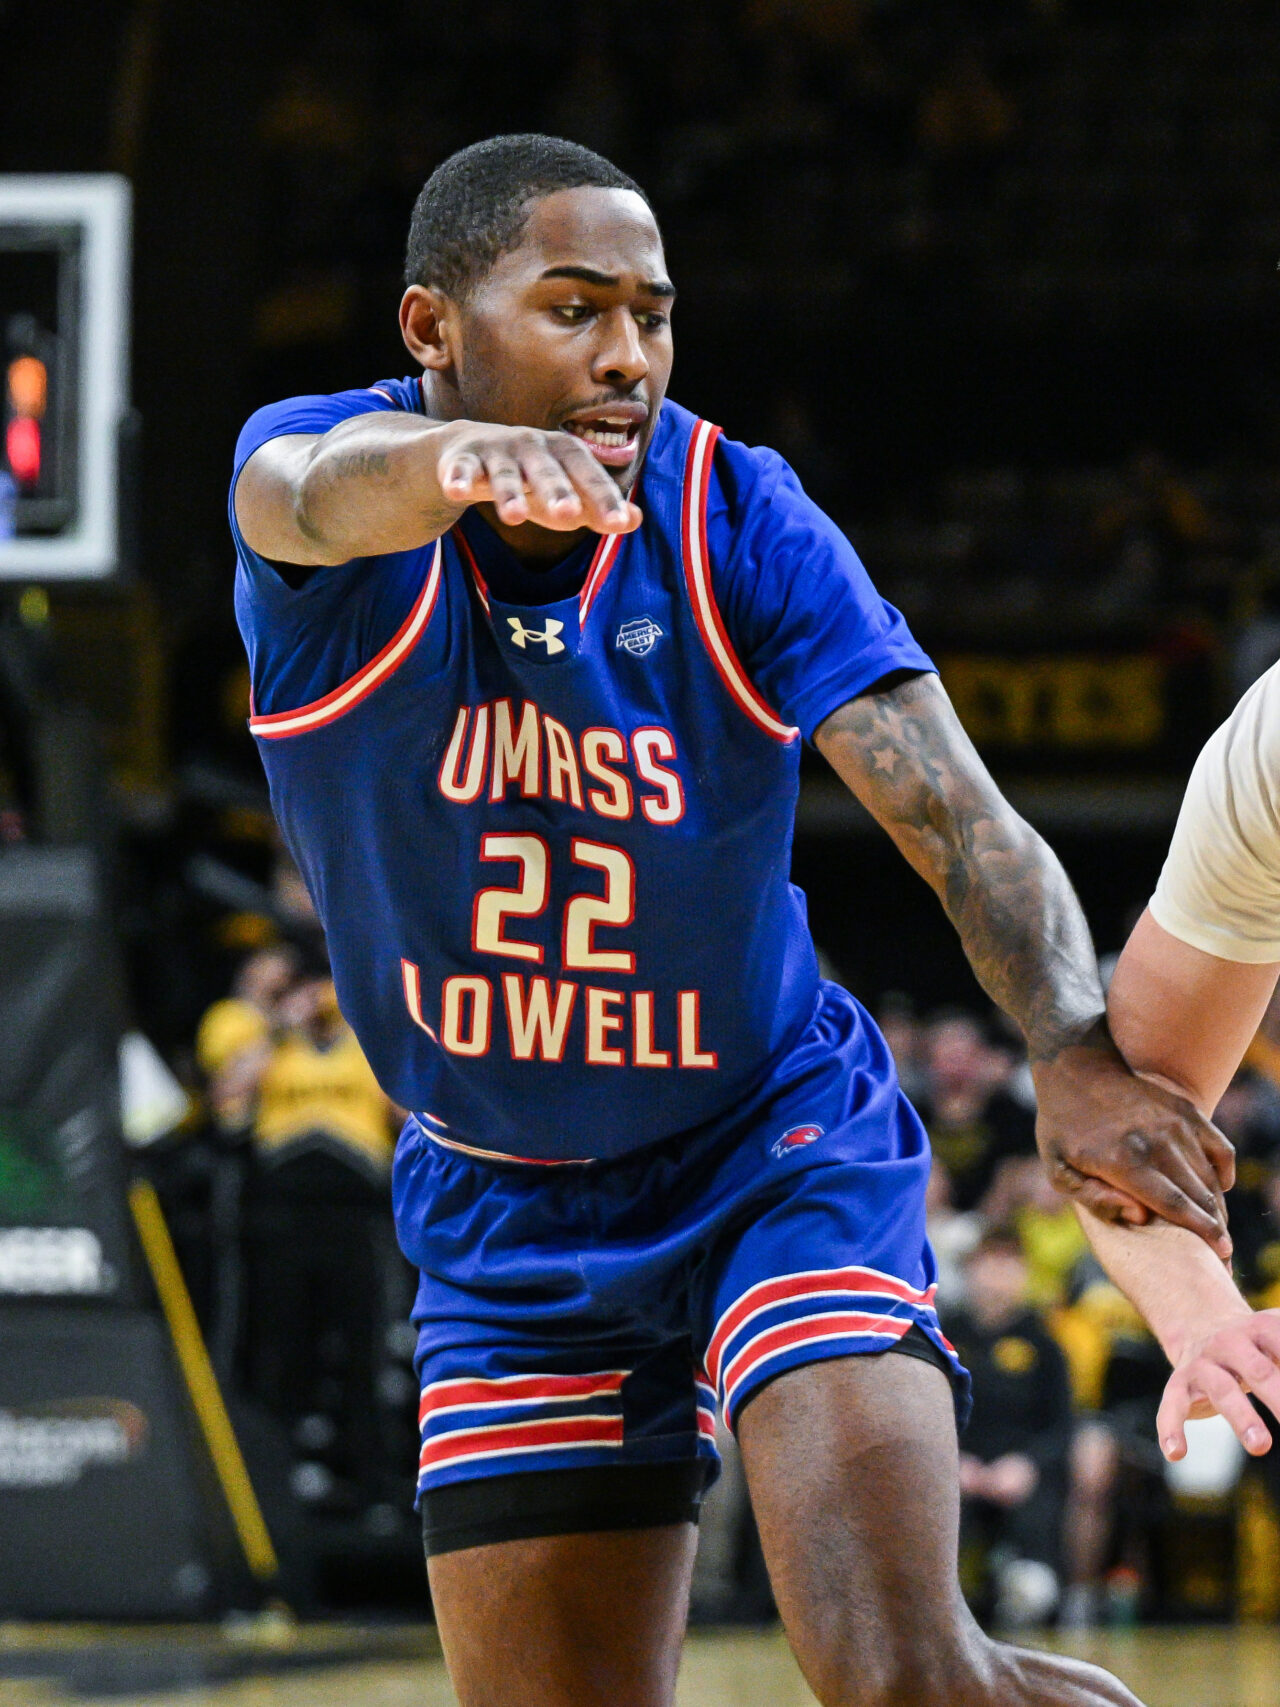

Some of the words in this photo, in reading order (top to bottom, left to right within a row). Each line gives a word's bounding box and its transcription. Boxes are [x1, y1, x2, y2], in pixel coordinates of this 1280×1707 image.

[437, 697, 685, 826] UMASS
[470, 831, 637, 975] 22
[401, 956, 719, 1070] LOWELL
